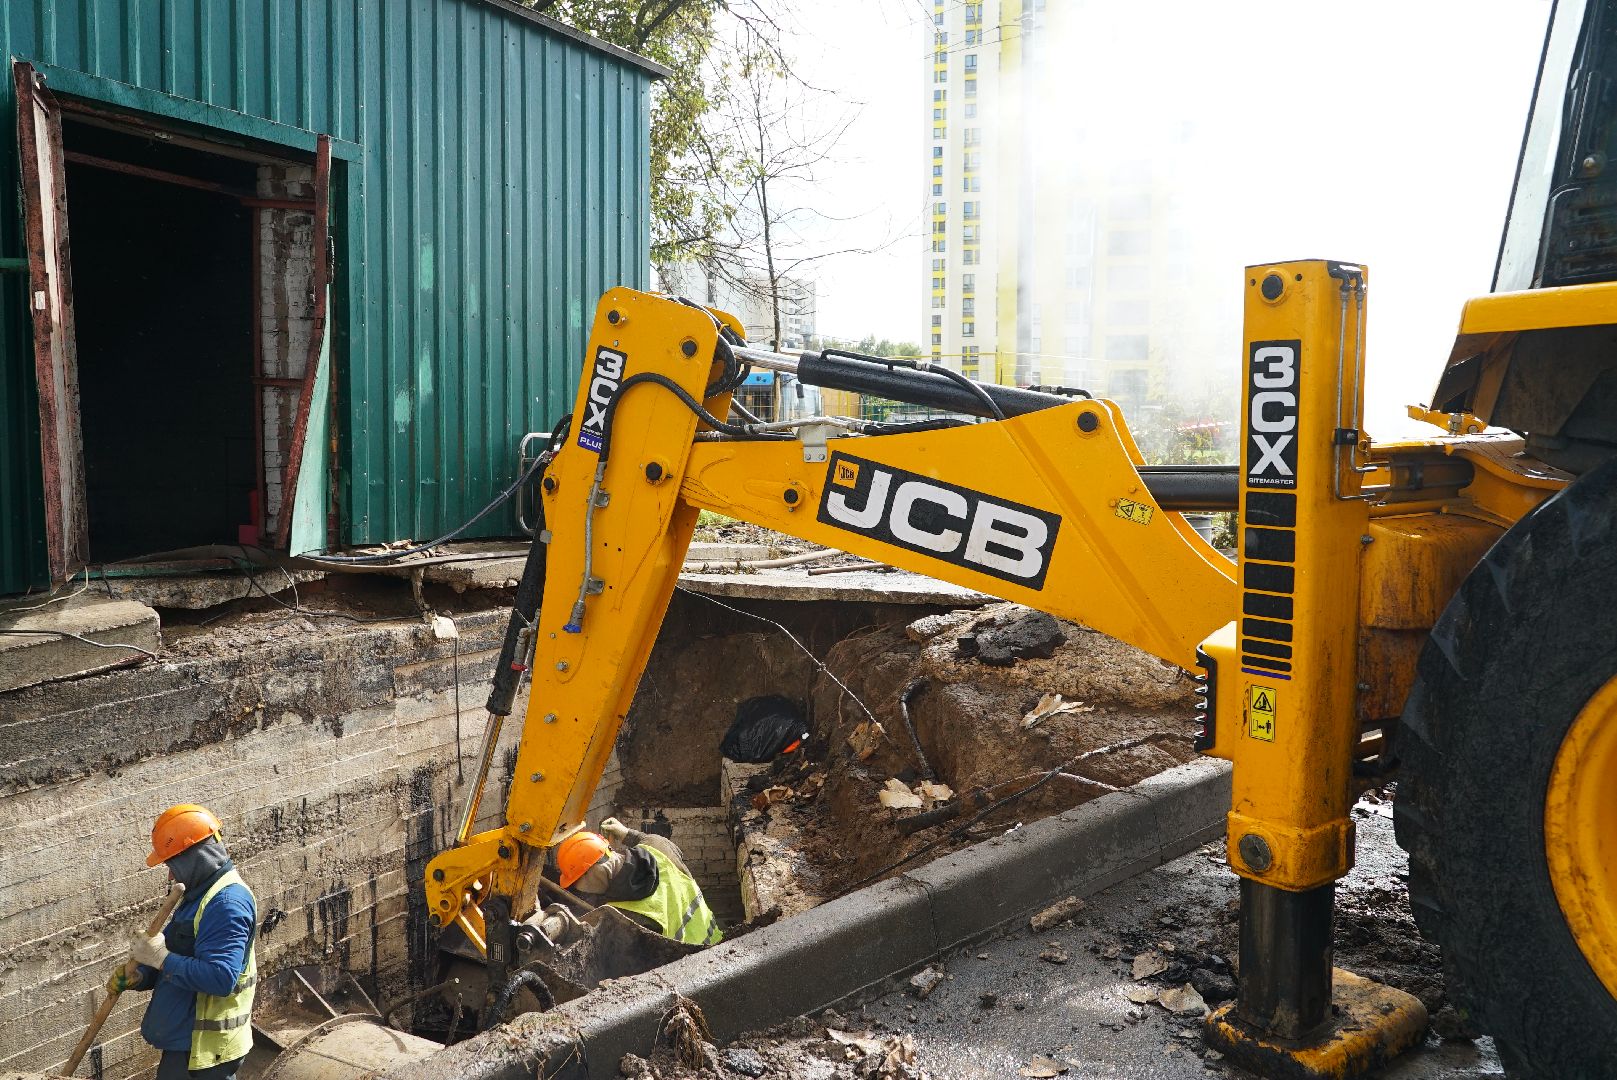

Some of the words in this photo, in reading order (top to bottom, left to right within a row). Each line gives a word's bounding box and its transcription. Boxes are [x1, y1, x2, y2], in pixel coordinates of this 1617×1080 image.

[583, 350, 623, 431] 3CX
[1249, 346, 1296, 476] 3CX
[839, 465, 855, 479] JCB
[1248, 477, 1294, 485] SITEMASTER
[826, 469, 1048, 578] JCB
